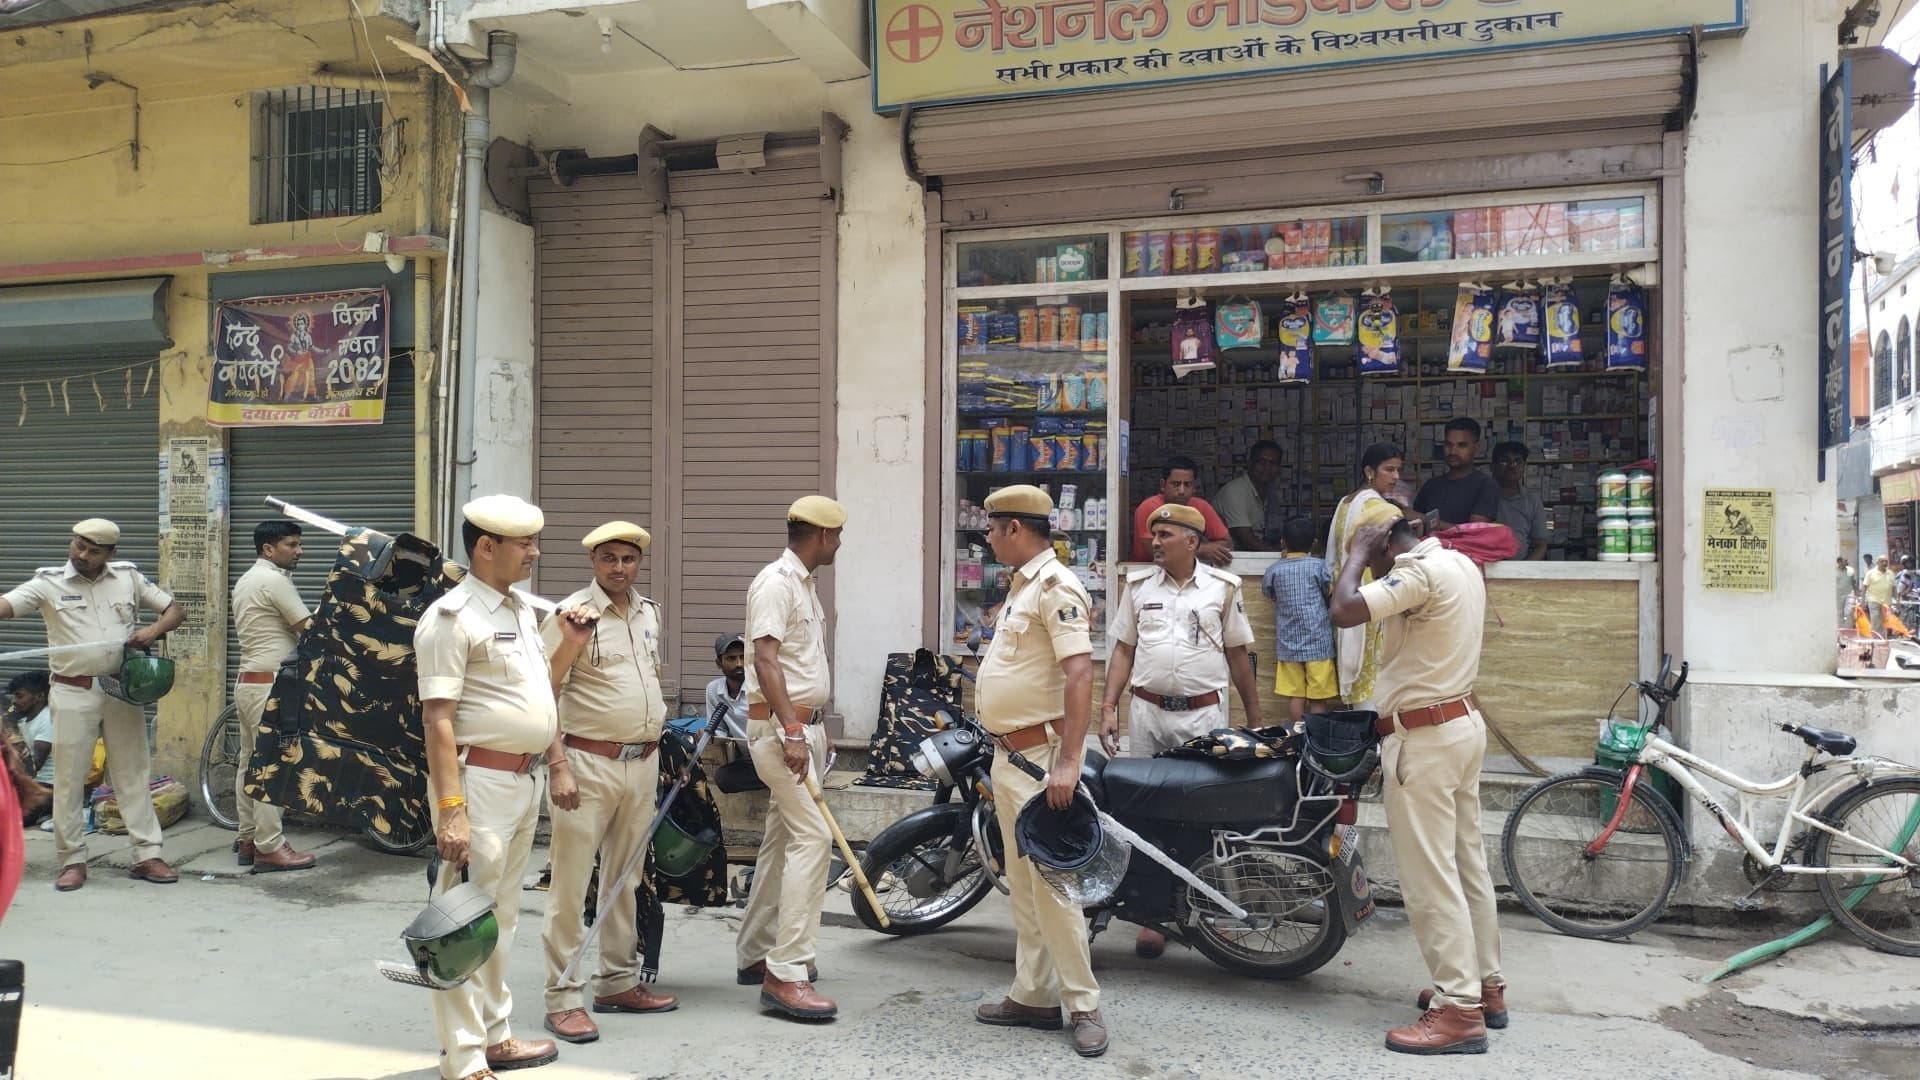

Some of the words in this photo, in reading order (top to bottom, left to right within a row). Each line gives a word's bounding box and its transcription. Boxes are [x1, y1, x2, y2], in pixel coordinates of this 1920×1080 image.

[995, 60, 1053, 82] सभी
[1056, 57, 1128, 79] प्रकार
[1133, 49, 1172, 70] की
[1178, 37, 1270, 65] दवाओं
[1275, 35, 1305, 54] के
[1311, 20, 1468, 51] विश्वसनीय
[1471, 12, 1563, 42] दुकान
[326, 356, 382, 383] 2082
[1707, 535, 1738, 550] मेनका
